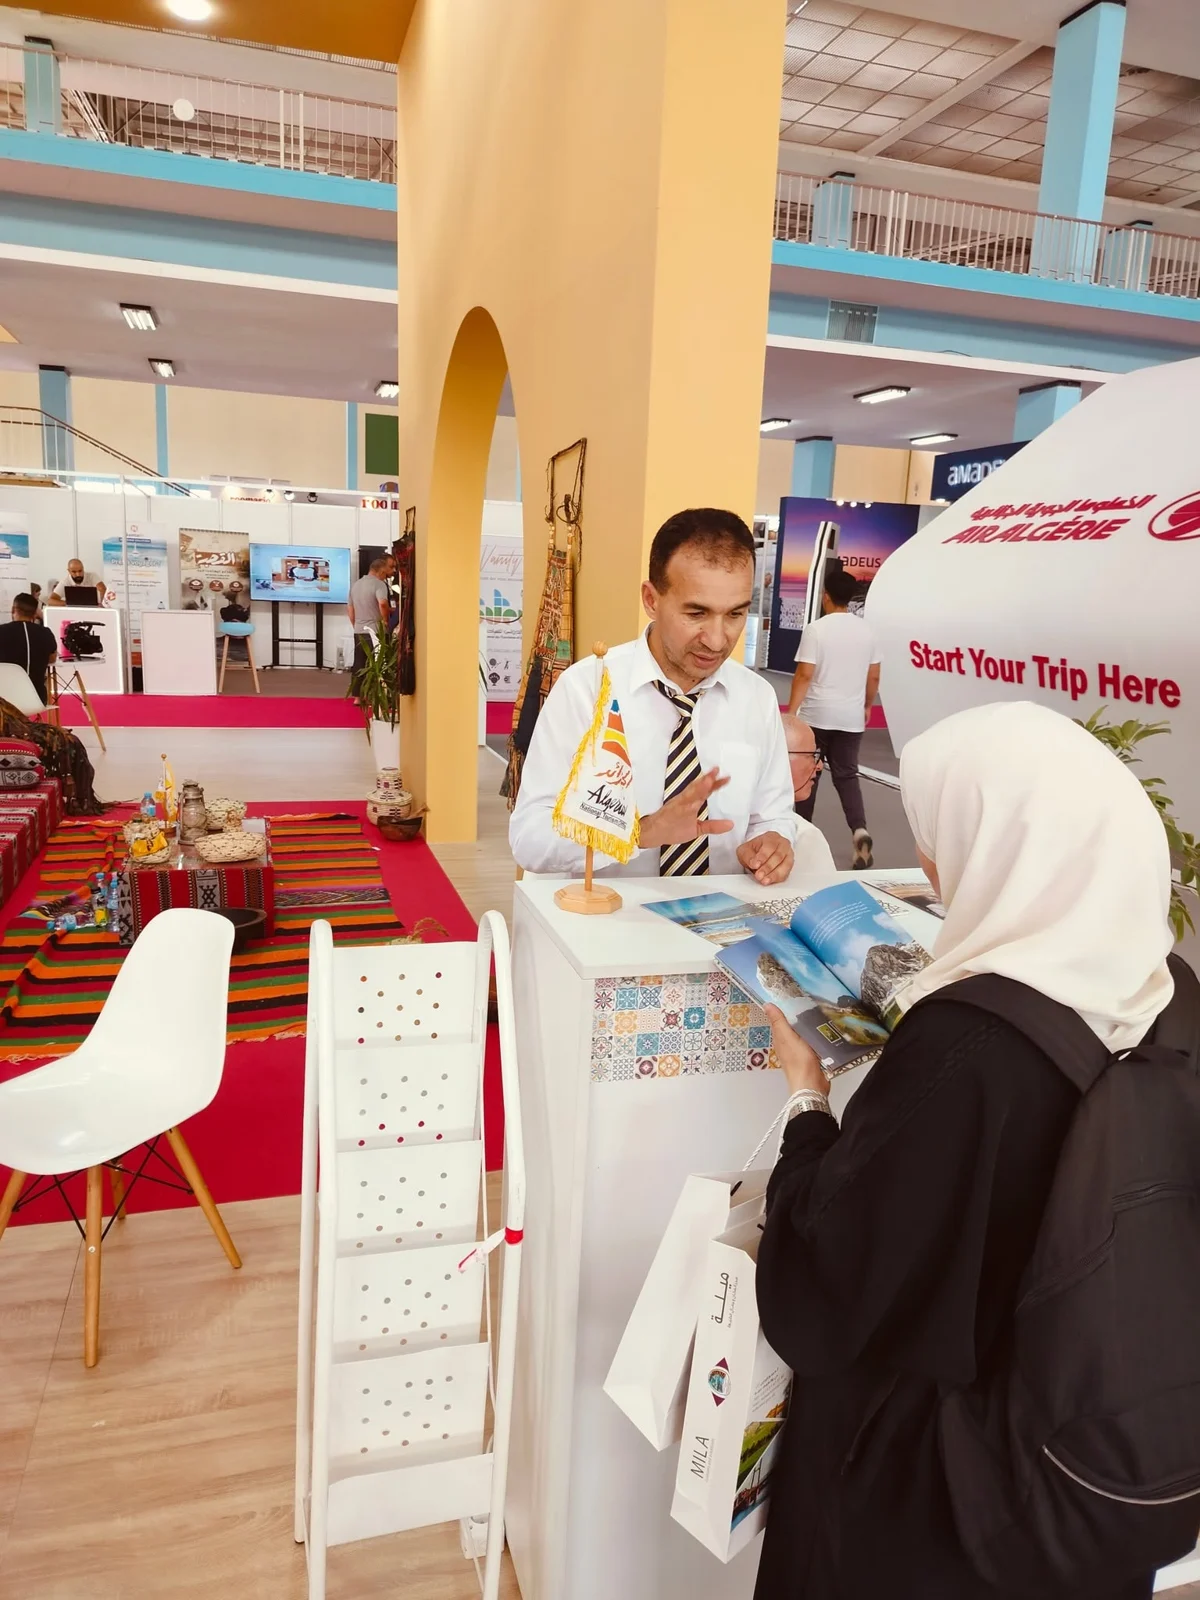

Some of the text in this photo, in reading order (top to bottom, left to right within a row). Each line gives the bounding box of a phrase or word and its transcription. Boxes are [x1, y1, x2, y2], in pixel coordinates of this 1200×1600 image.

[941, 515, 1131, 544] AIR ALGÉRIE
[909, 640, 1181, 709] Start Your Trip Here
[690, 1435, 710, 1479] MILA
